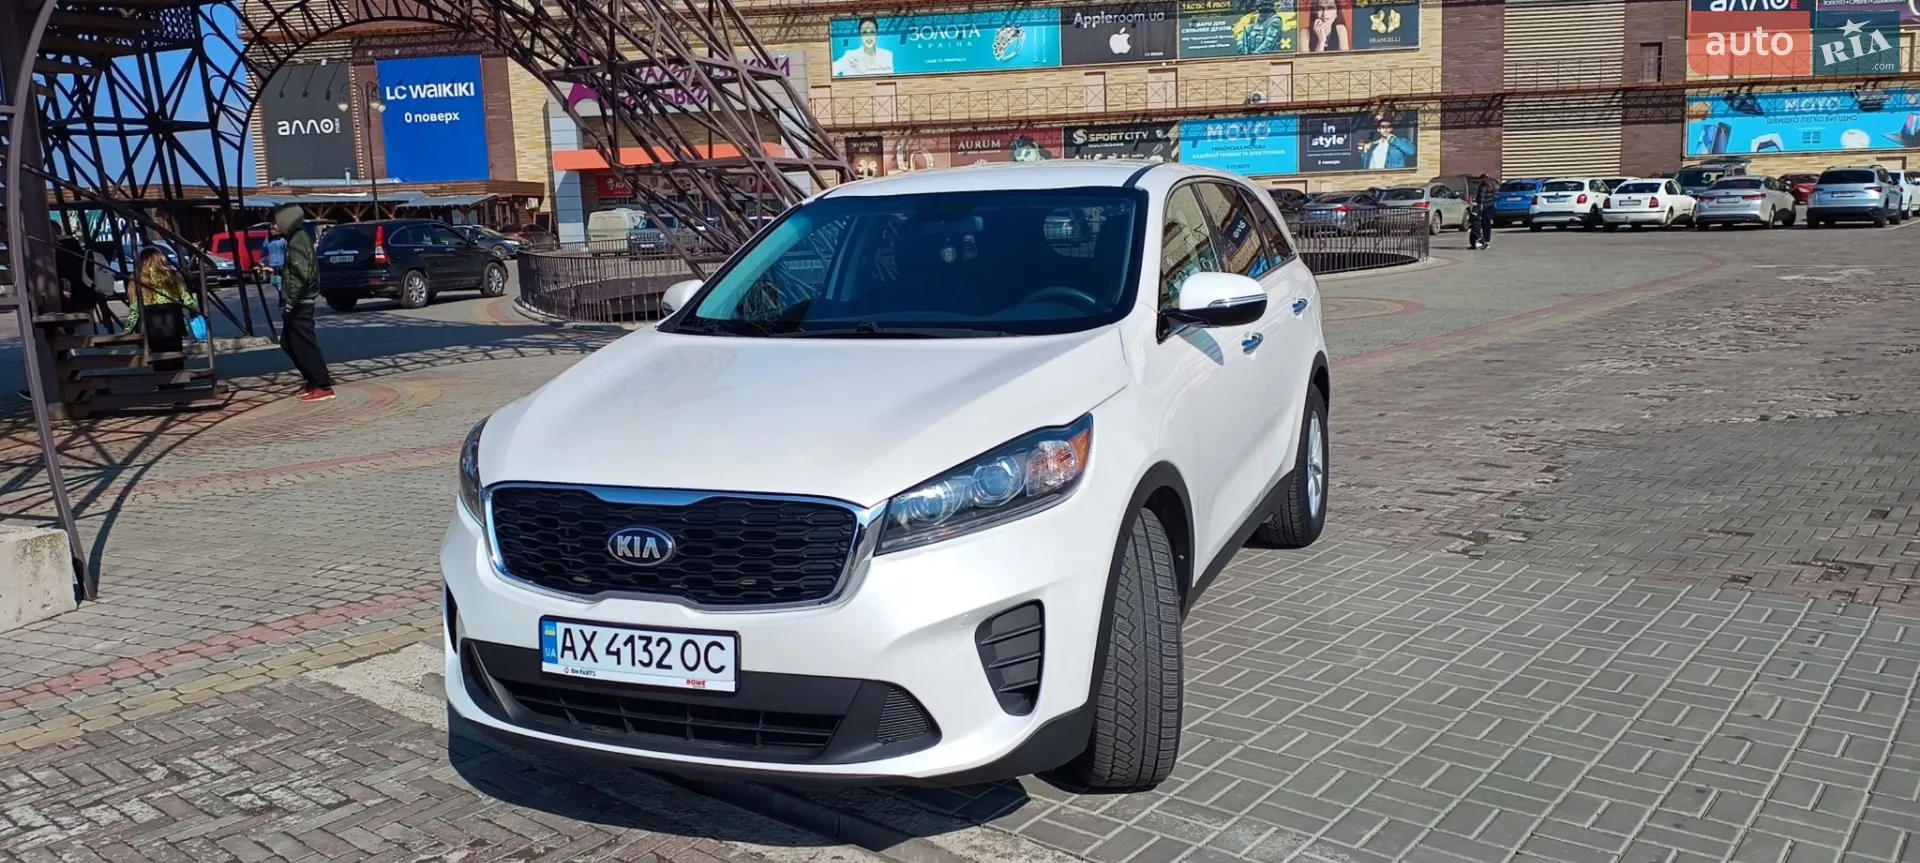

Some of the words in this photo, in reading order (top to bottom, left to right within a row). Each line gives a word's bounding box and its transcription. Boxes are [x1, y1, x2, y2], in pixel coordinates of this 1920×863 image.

[1073, 10, 1165, 28] Appleroom.ua
[908, 23, 982, 41] ЗОЛОТА
[386, 85, 407, 100] LC
[414, 112, 460, 124] поверх
[1767, 117, 1799, 125] ШВИДКО
[1825, 114, 1858, 122] ВИГІДНО
[1323, 122, 1336, 134] in
[958, 139, 1001, 149] AURUM
[617, 535, 661, 558] KIA
[545, 648, 557, 658] UA
[560, 628, 598, 663] AX
[605, 633, 673, 670] 4132
[680, 639, 726, 674] OC
